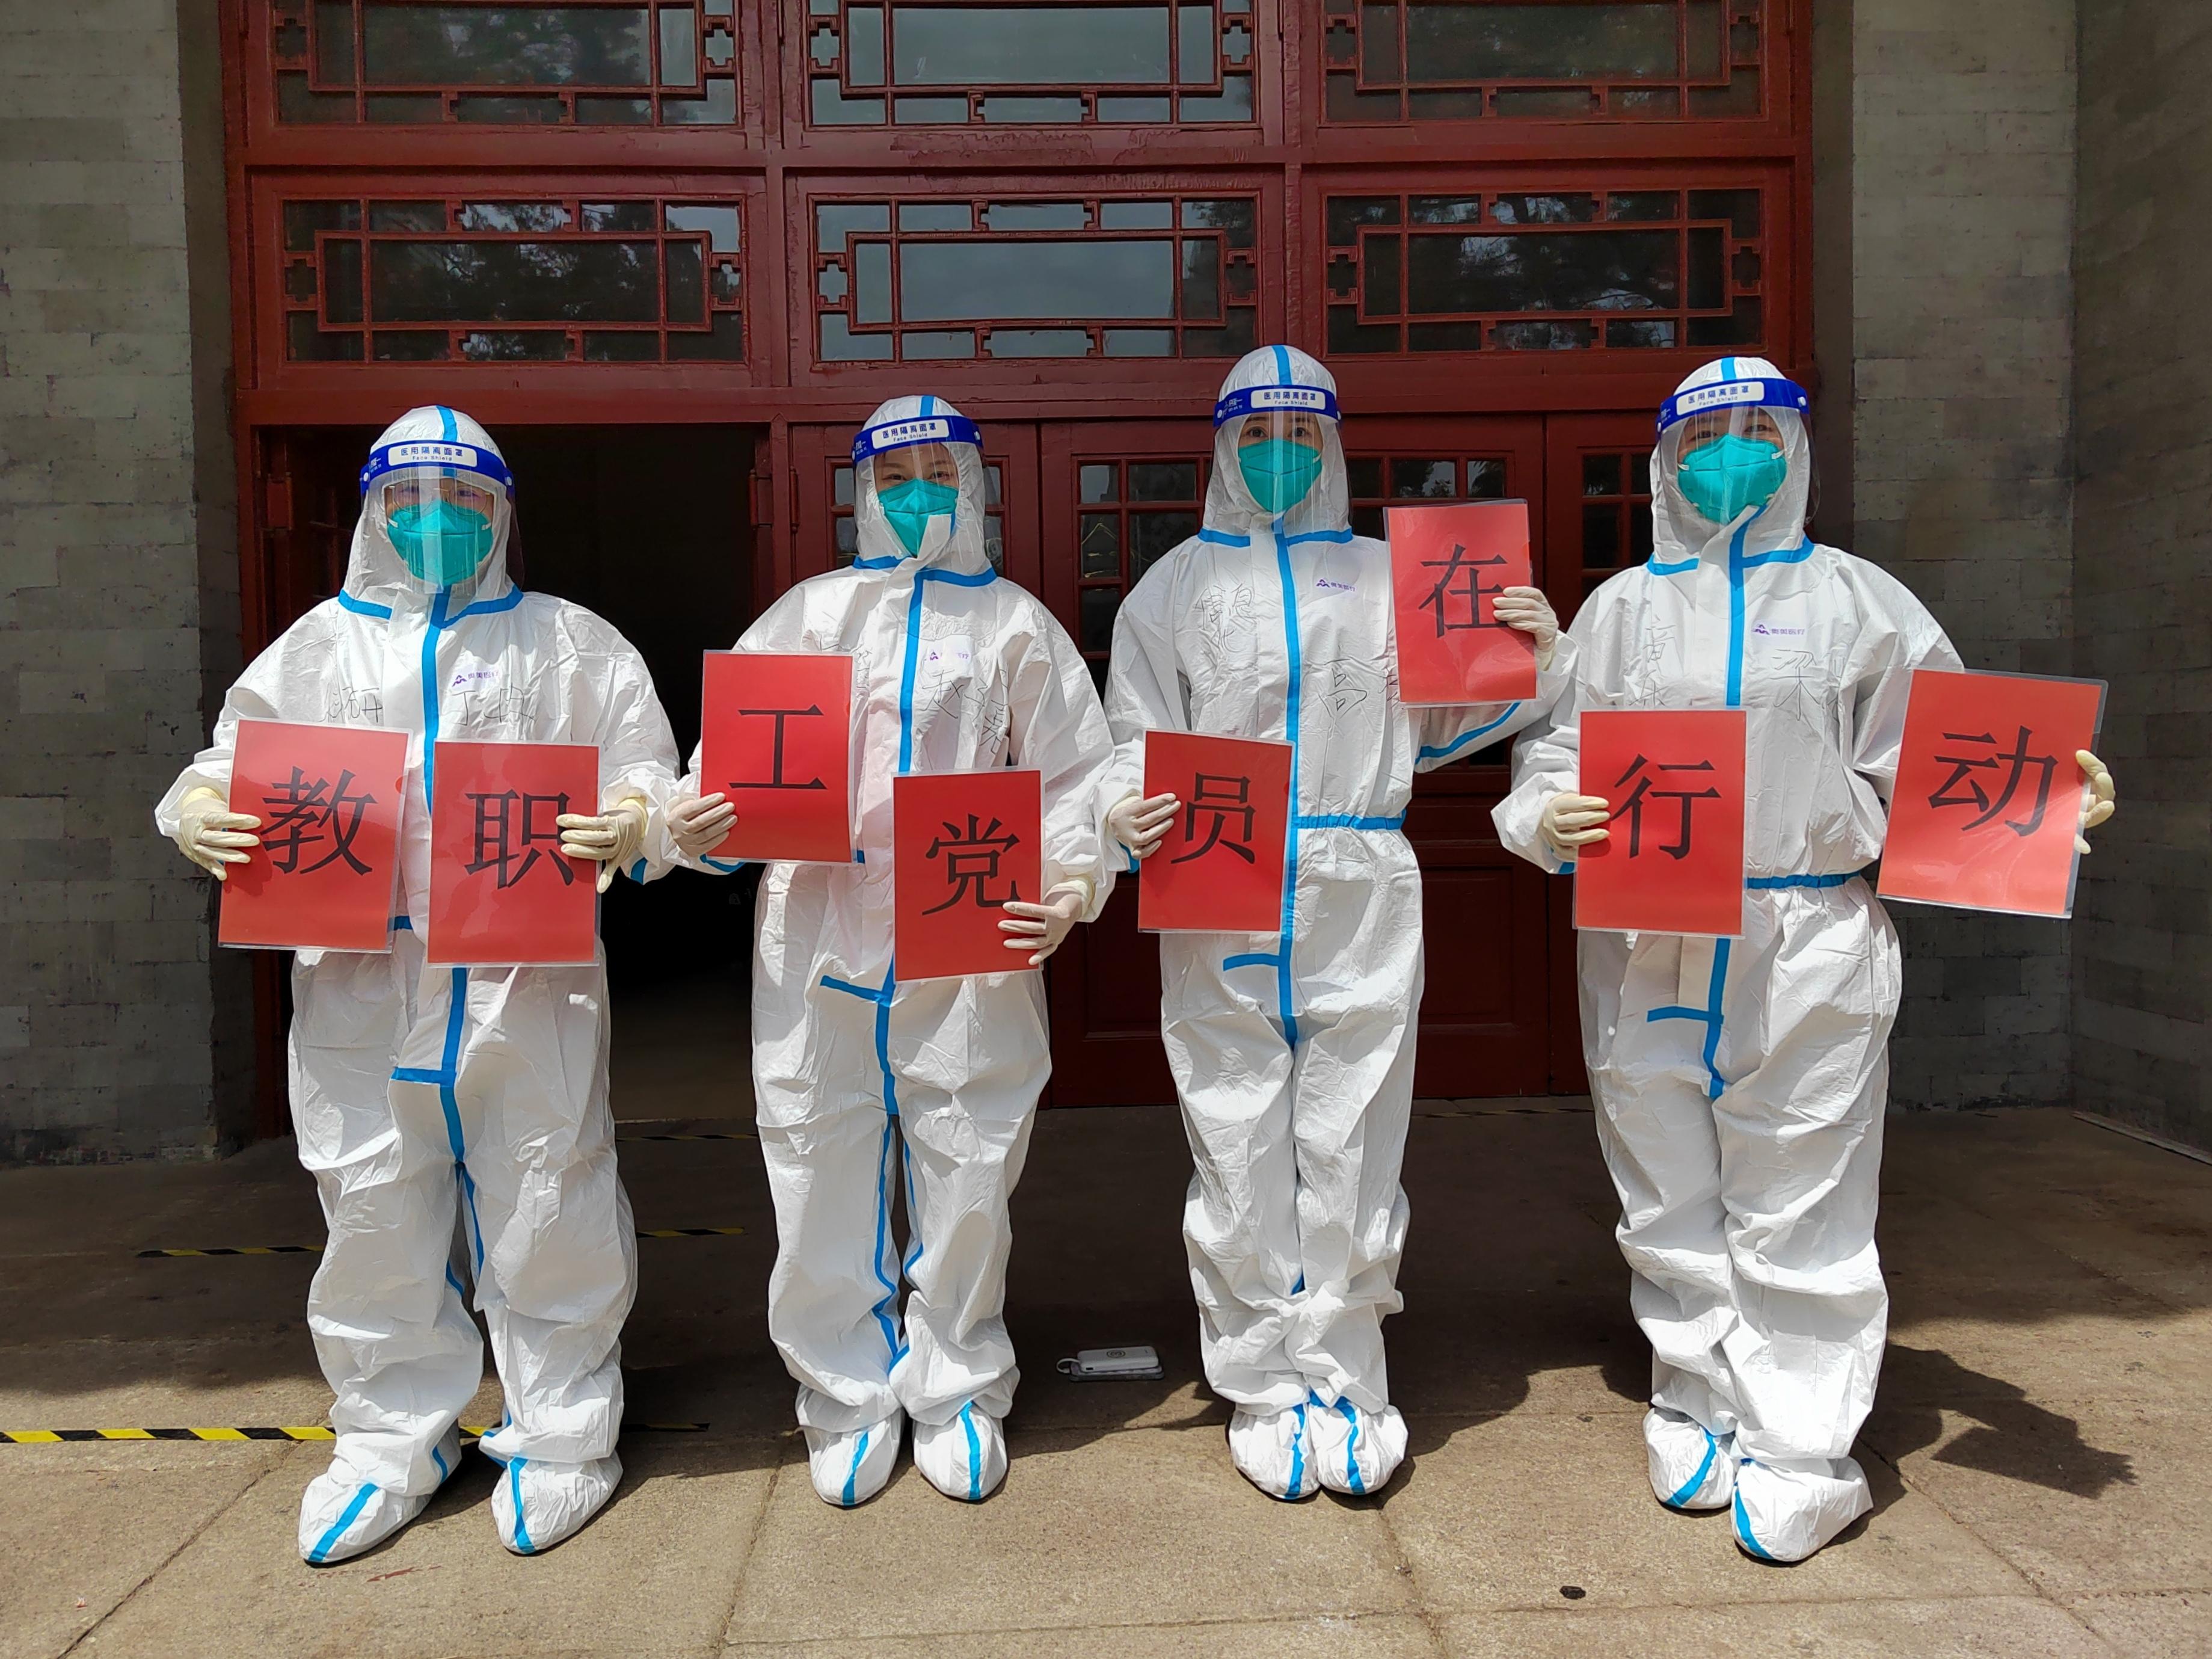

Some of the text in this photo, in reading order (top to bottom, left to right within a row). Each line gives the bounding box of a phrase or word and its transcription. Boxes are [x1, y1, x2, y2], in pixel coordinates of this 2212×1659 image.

[1418, 543, 1508, 638] 在
[728, 704, 828, 790] 工
[1928, 725, 2059, 837] 动
[260, 766, 377, 875] 教
[464, 789, 574, 889] 职
[1170, 772, 1256, 864] 员
[1610, 753, 1721, 860] 行
[922, 813, 1021, 916] 党
